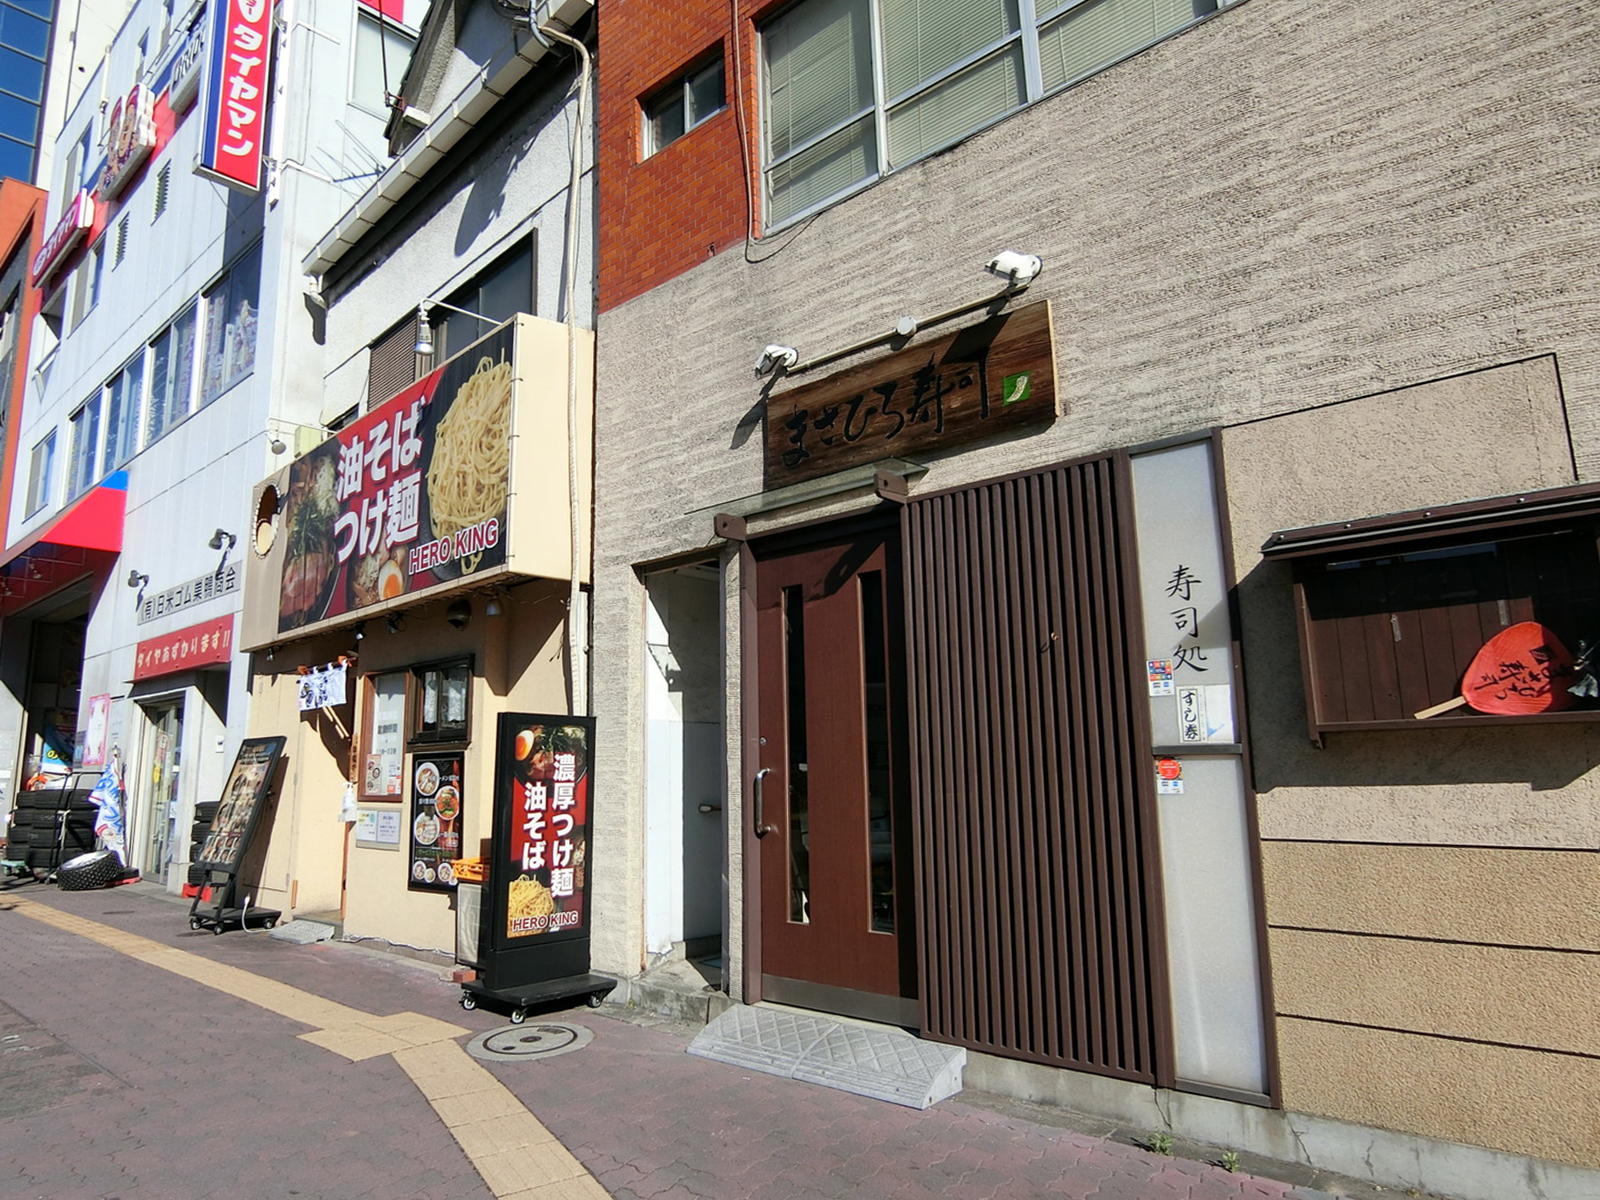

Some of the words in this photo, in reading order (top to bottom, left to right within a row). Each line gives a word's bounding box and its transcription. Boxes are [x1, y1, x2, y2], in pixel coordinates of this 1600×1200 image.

[222, 24, 263, 156] タイヤマン
[337, 397, 425, 501] 油そば
[782, 350, 990, 467] まさひろ寿司
[334, 470, 422, 564] つけ麺
[409, 536, 450, 574] HERO
[455, 518, 499, 558] KING
[1165, 565, 1208, 672] 寿司処
[1182, 691, 1199, 740] すし券
[522, 782, 547, 871] 油そば
[551, 753, 576, 898] 濃厚つけ麺
[512, 914, 547, 932] HERO
[549, 911, 579, 927] KING
